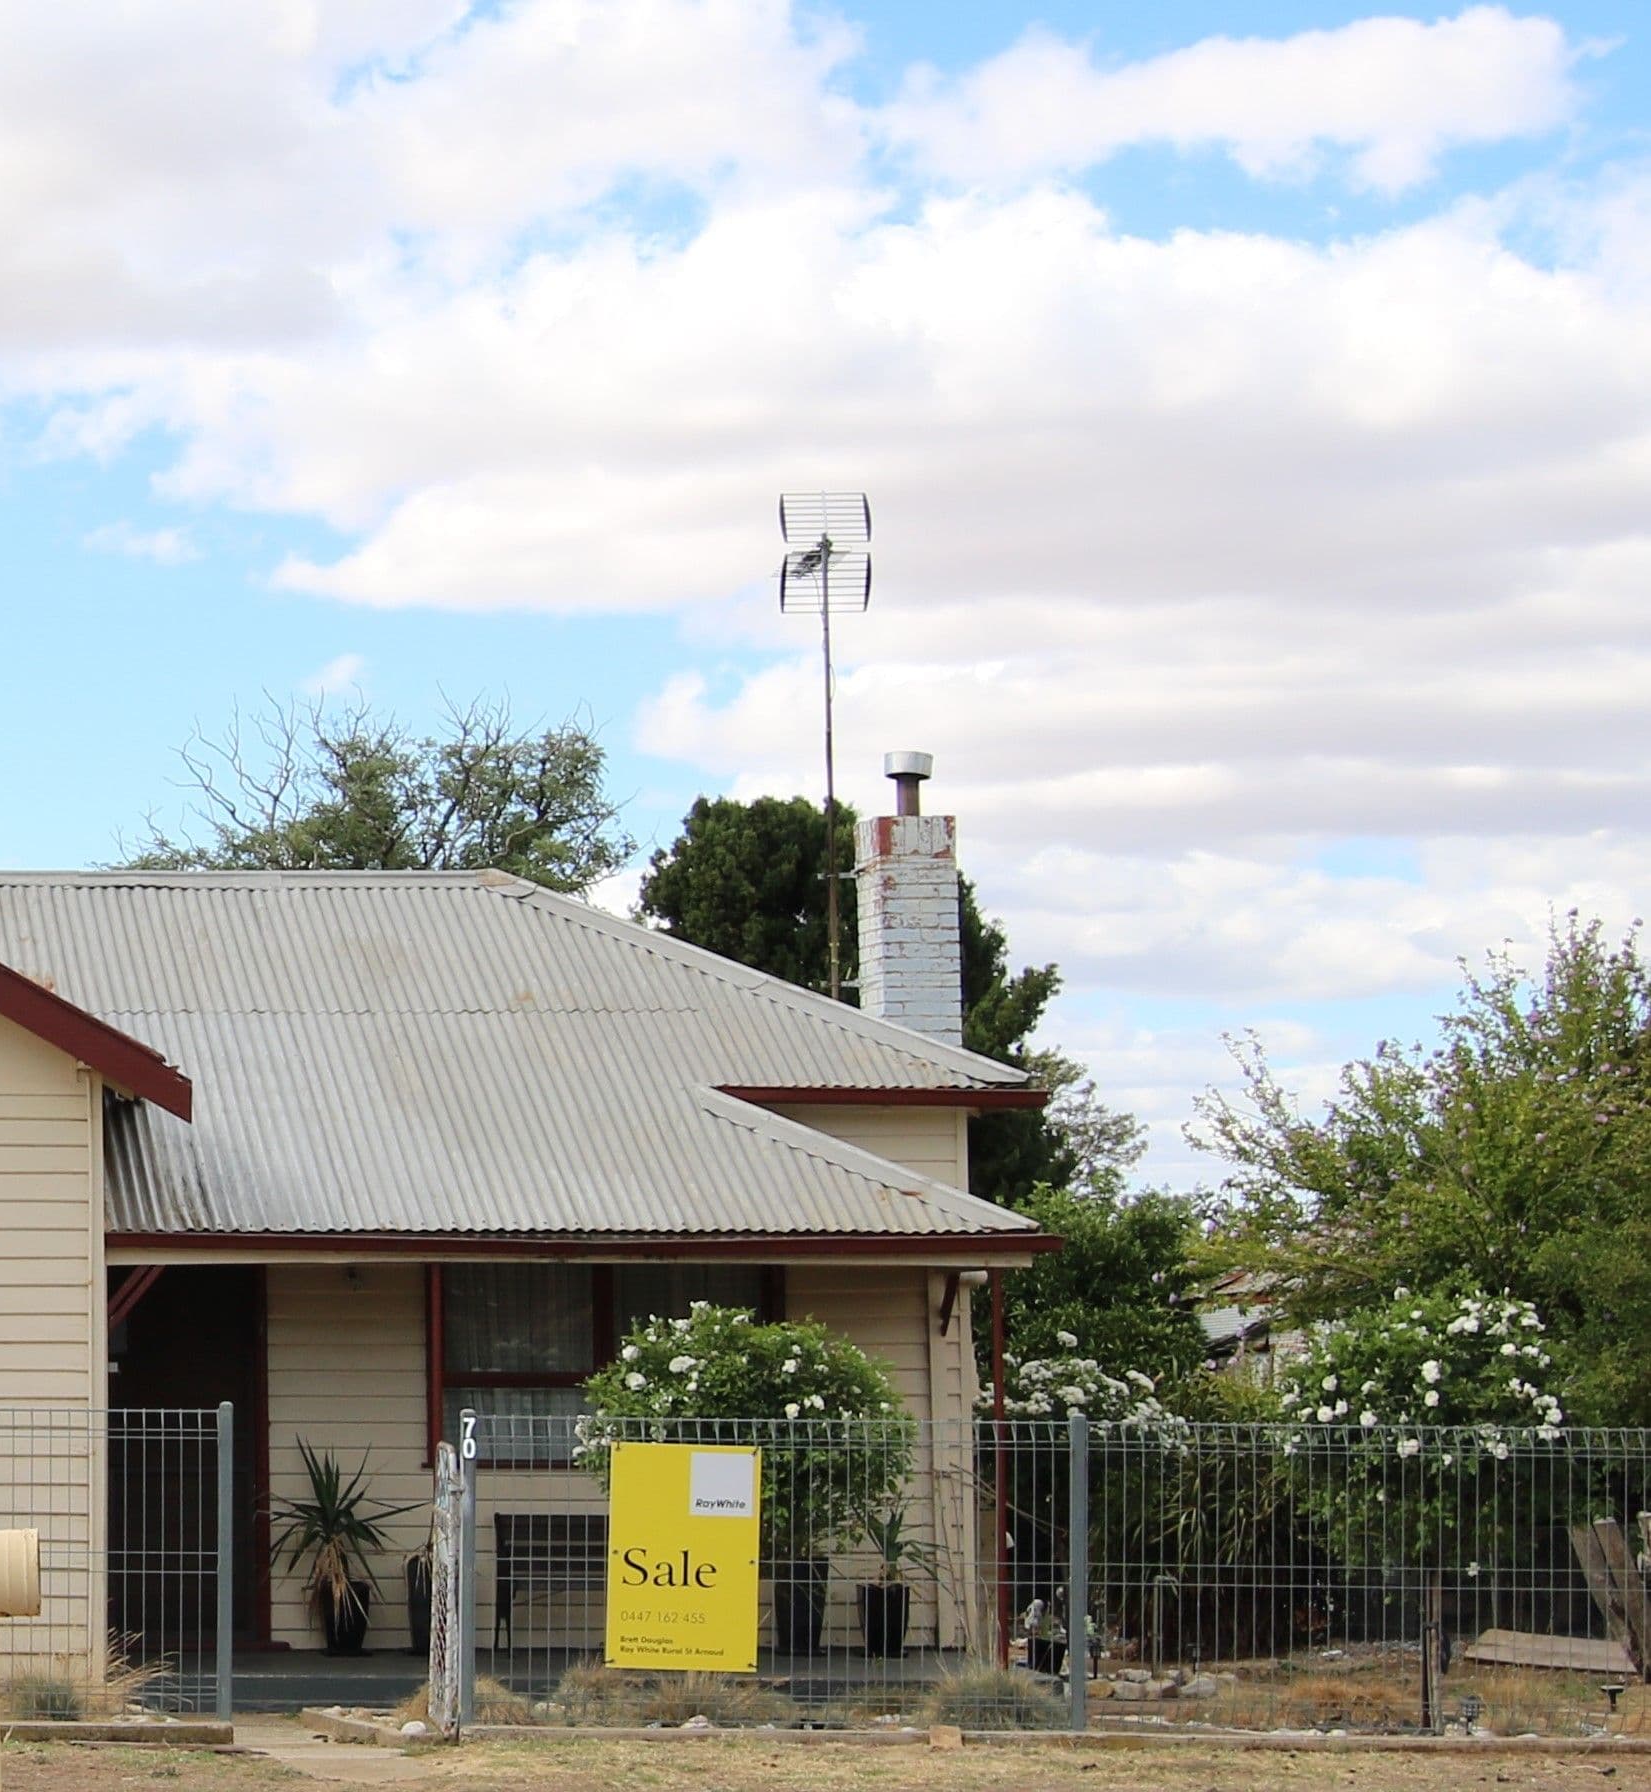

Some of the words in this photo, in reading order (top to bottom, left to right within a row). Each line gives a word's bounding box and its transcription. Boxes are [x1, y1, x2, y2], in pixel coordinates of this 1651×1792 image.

[463, 1417, 476, 1459] 70
[695, 1498, 746, 1510] RayWhite
[621, 1548, 717, 1589] Sale
[620, 1610, 652, 1622] 0447
[657, 1611, 678, 1624] 162
[683, 1612, 706, 1625] 455
[620, 1635, 639, 1643] Brett
[641, 1636, 673, 1646] Douglas
[620, 1646, 635, 1654] Ray
[637, 1646, 660, 1654] White
[662, 1647, 683, 1655] Rural
[685, 1647, 693, 1655] St
[695, 1648, 724, 1656] Arnaud
